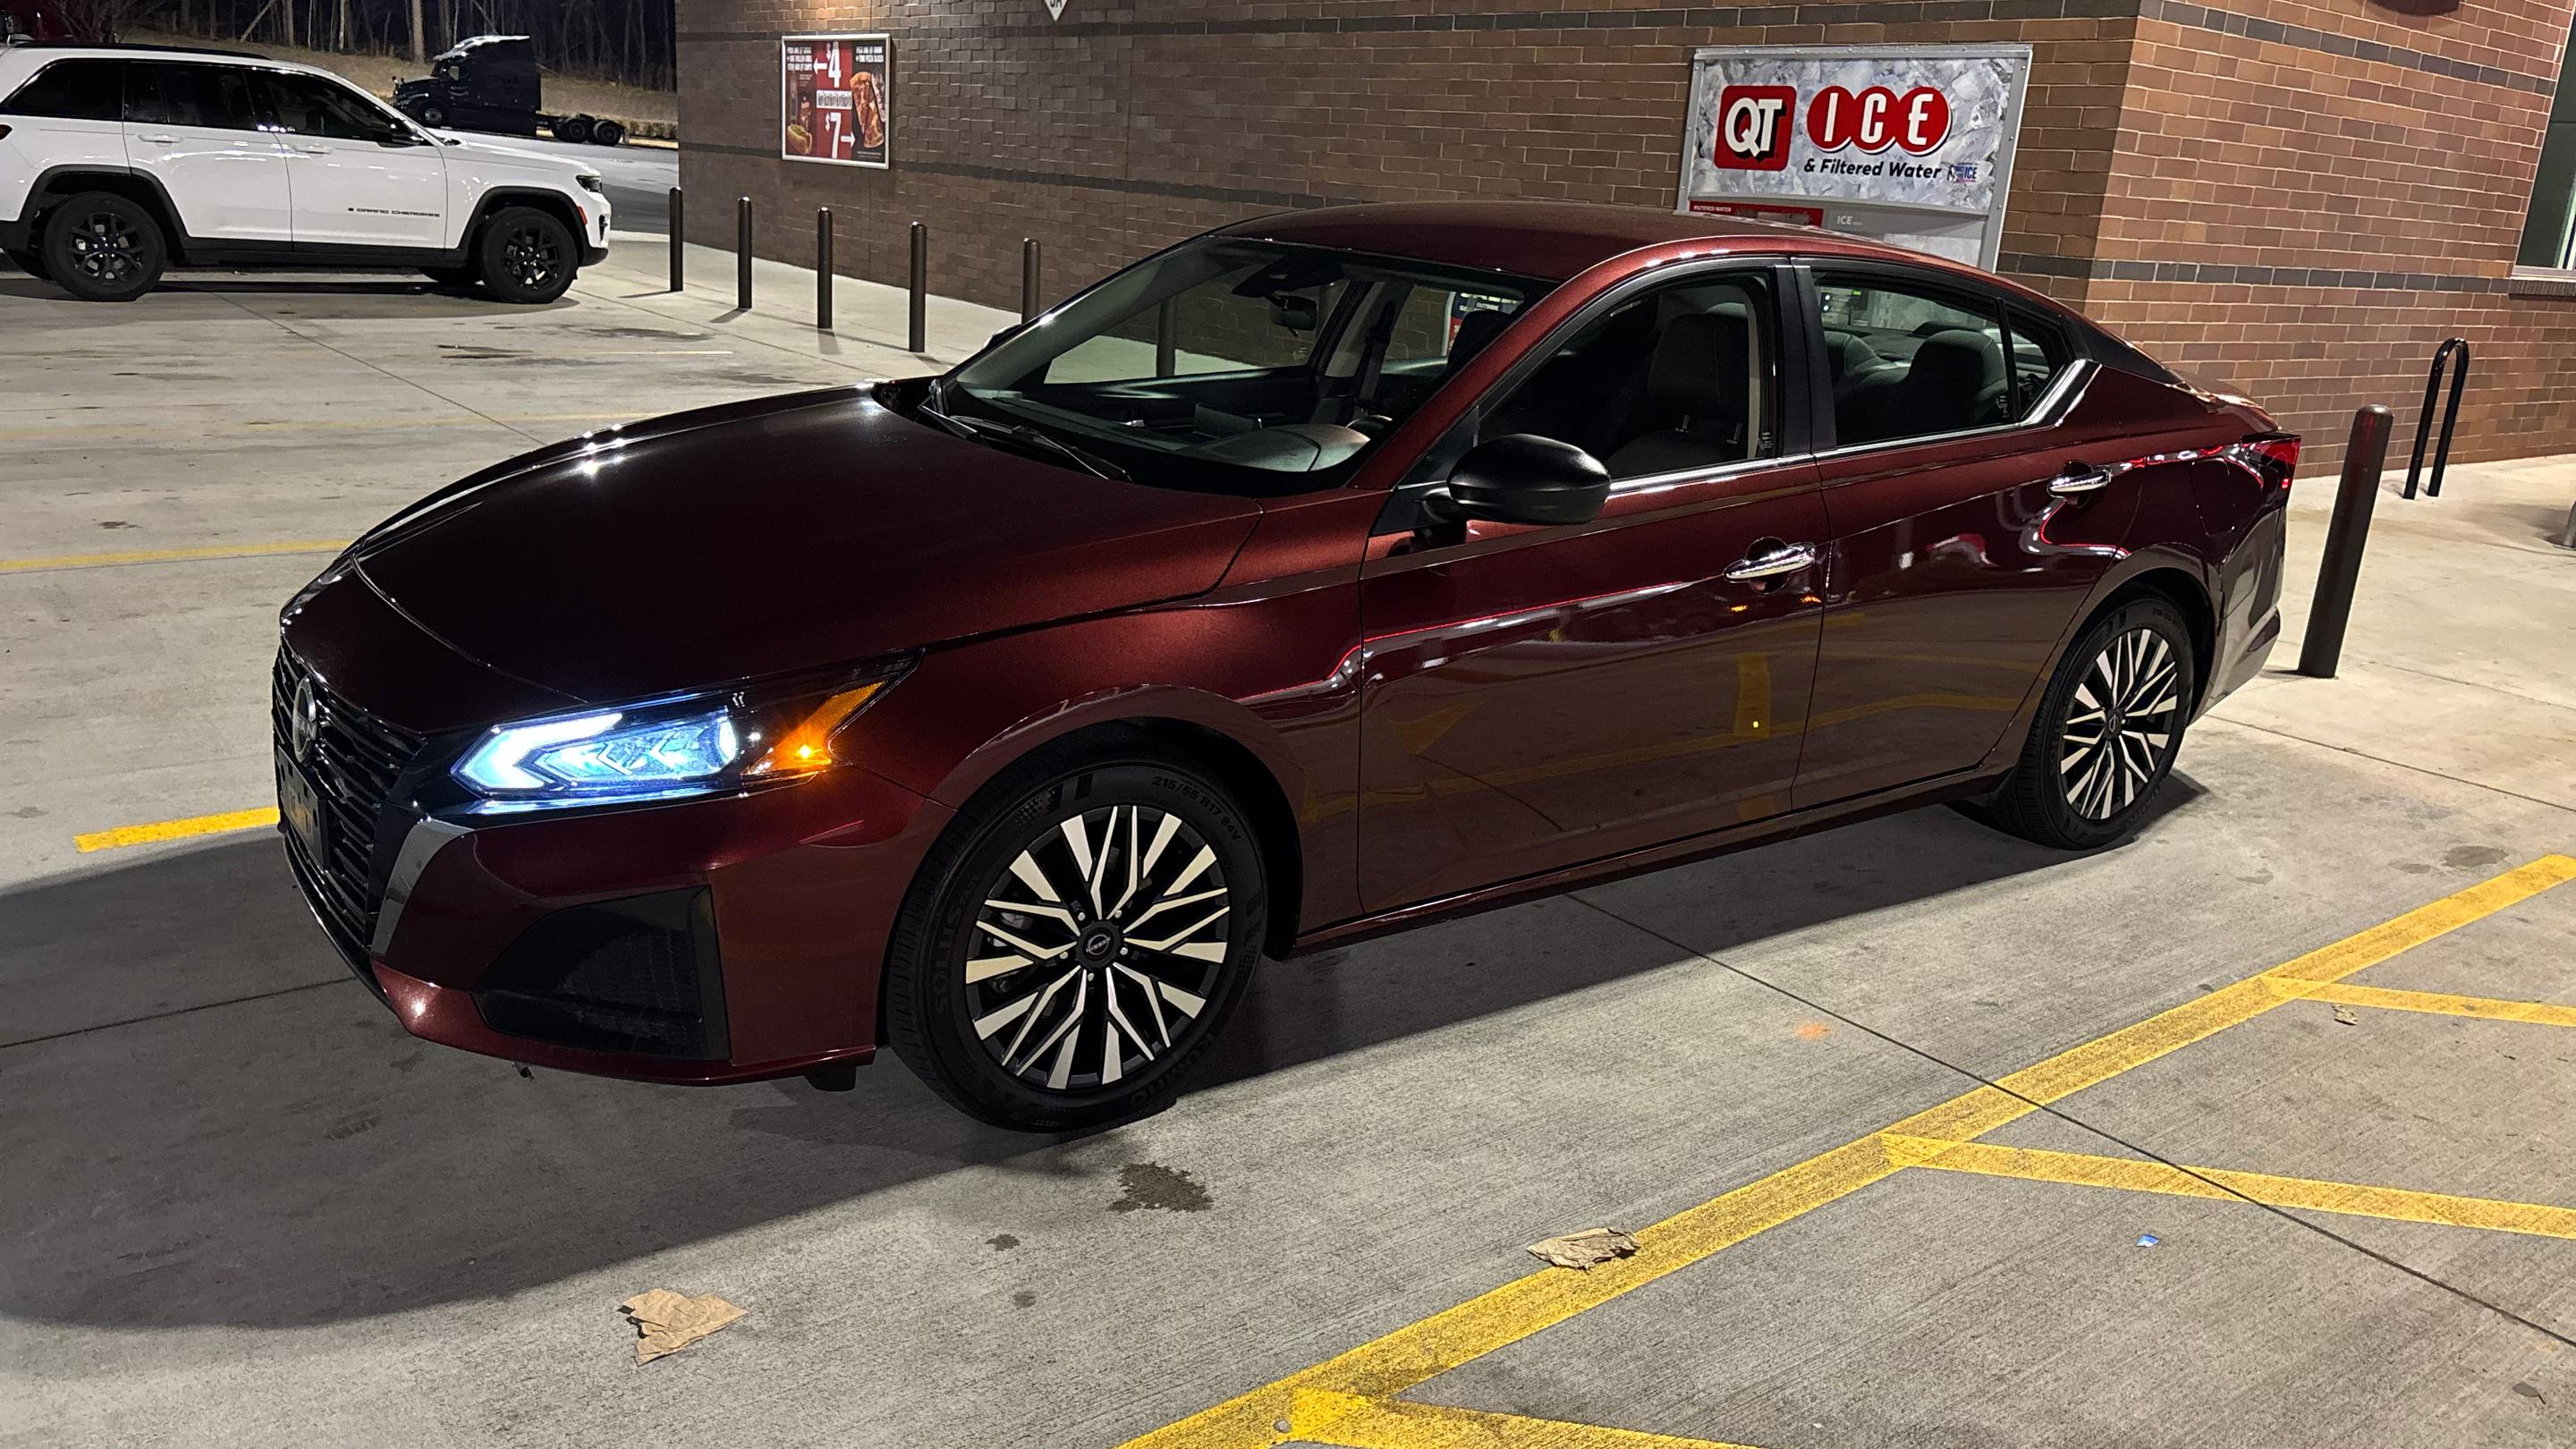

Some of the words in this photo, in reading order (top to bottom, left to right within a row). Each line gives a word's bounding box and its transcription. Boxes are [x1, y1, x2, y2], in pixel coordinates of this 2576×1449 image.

[825, 112, 842, 159] $7
[1724, 97, 1784, 157] QT
[1824, 92, 1934, 146] ICE
[1803, 157, 1816, 173] &
[1819, 157, 1884, 176] Filtered
[1888, 161, 1942, 179] Water
[1836, 215, 1853, 225] ICE
[1151, 775, 1200, 800] 215/55
[1199, 796, 1222, 815] R17
